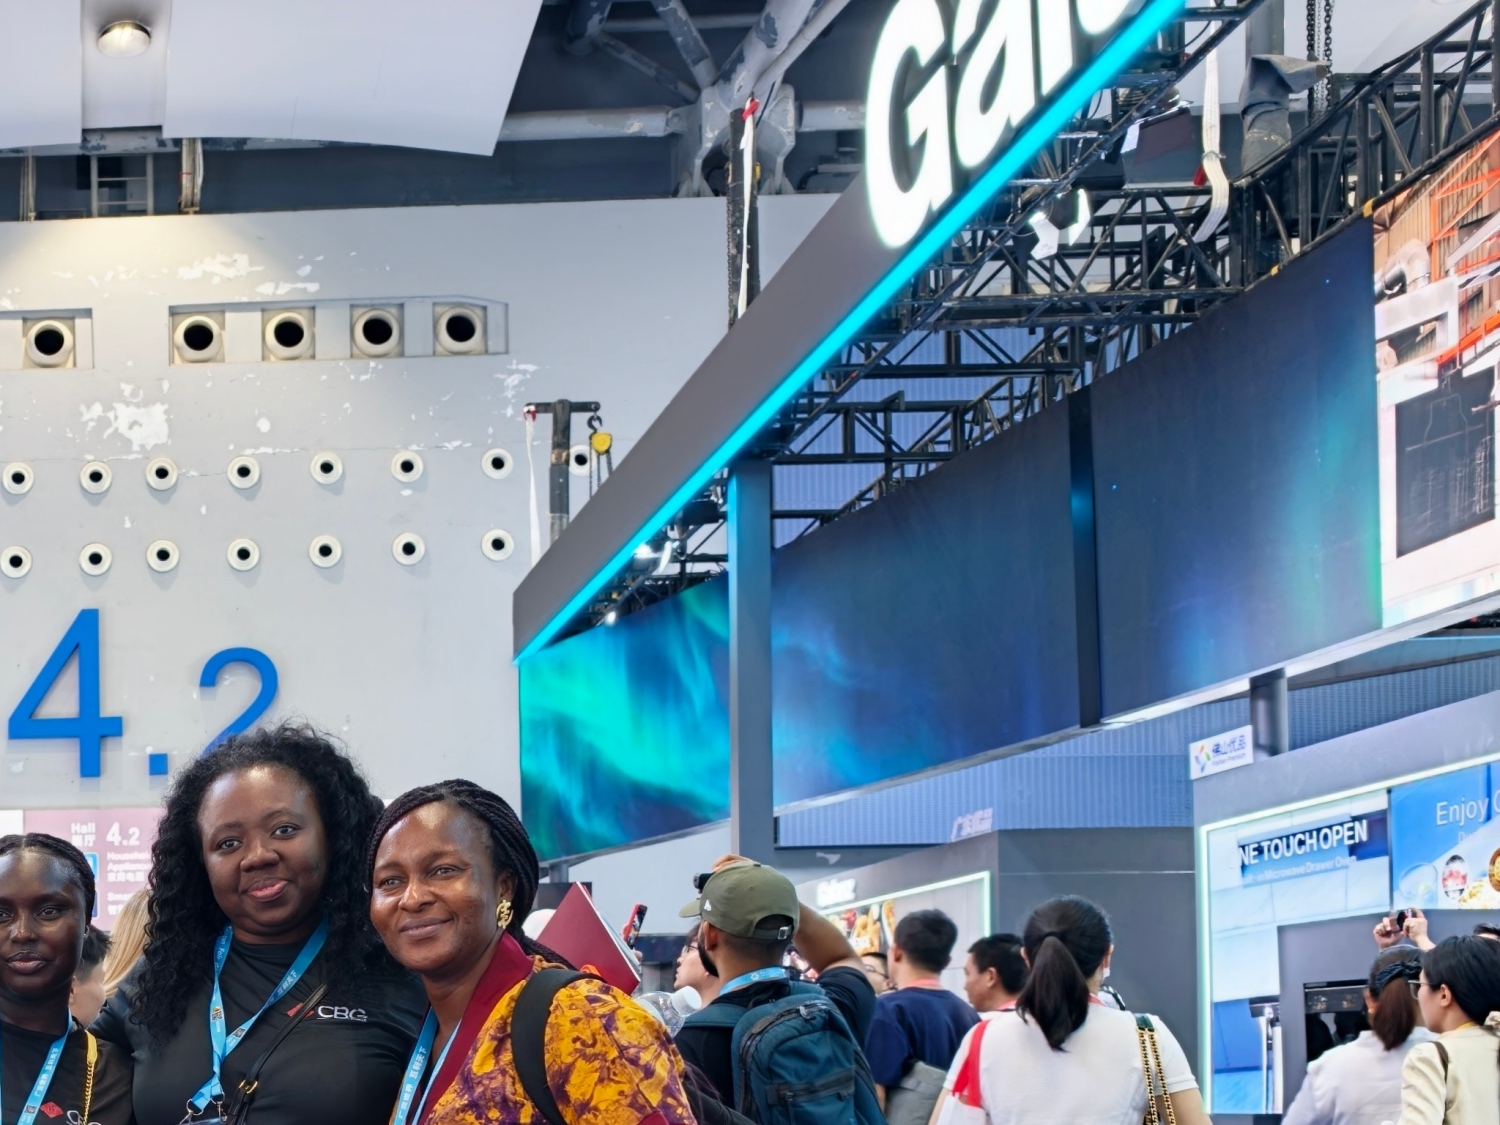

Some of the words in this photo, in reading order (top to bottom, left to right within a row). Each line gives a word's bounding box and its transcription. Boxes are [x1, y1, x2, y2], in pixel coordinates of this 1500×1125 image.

[8, 608, 278, 778] 4.2
[1436, 796, 1489, 827] Enjoy
[71, 822, 95, 834] Hall
[106, 822, 140, 846] 4.2
[1260, 831, 1317, 861] TOUCH
[1319, 819, 1368, 850] OPEN
